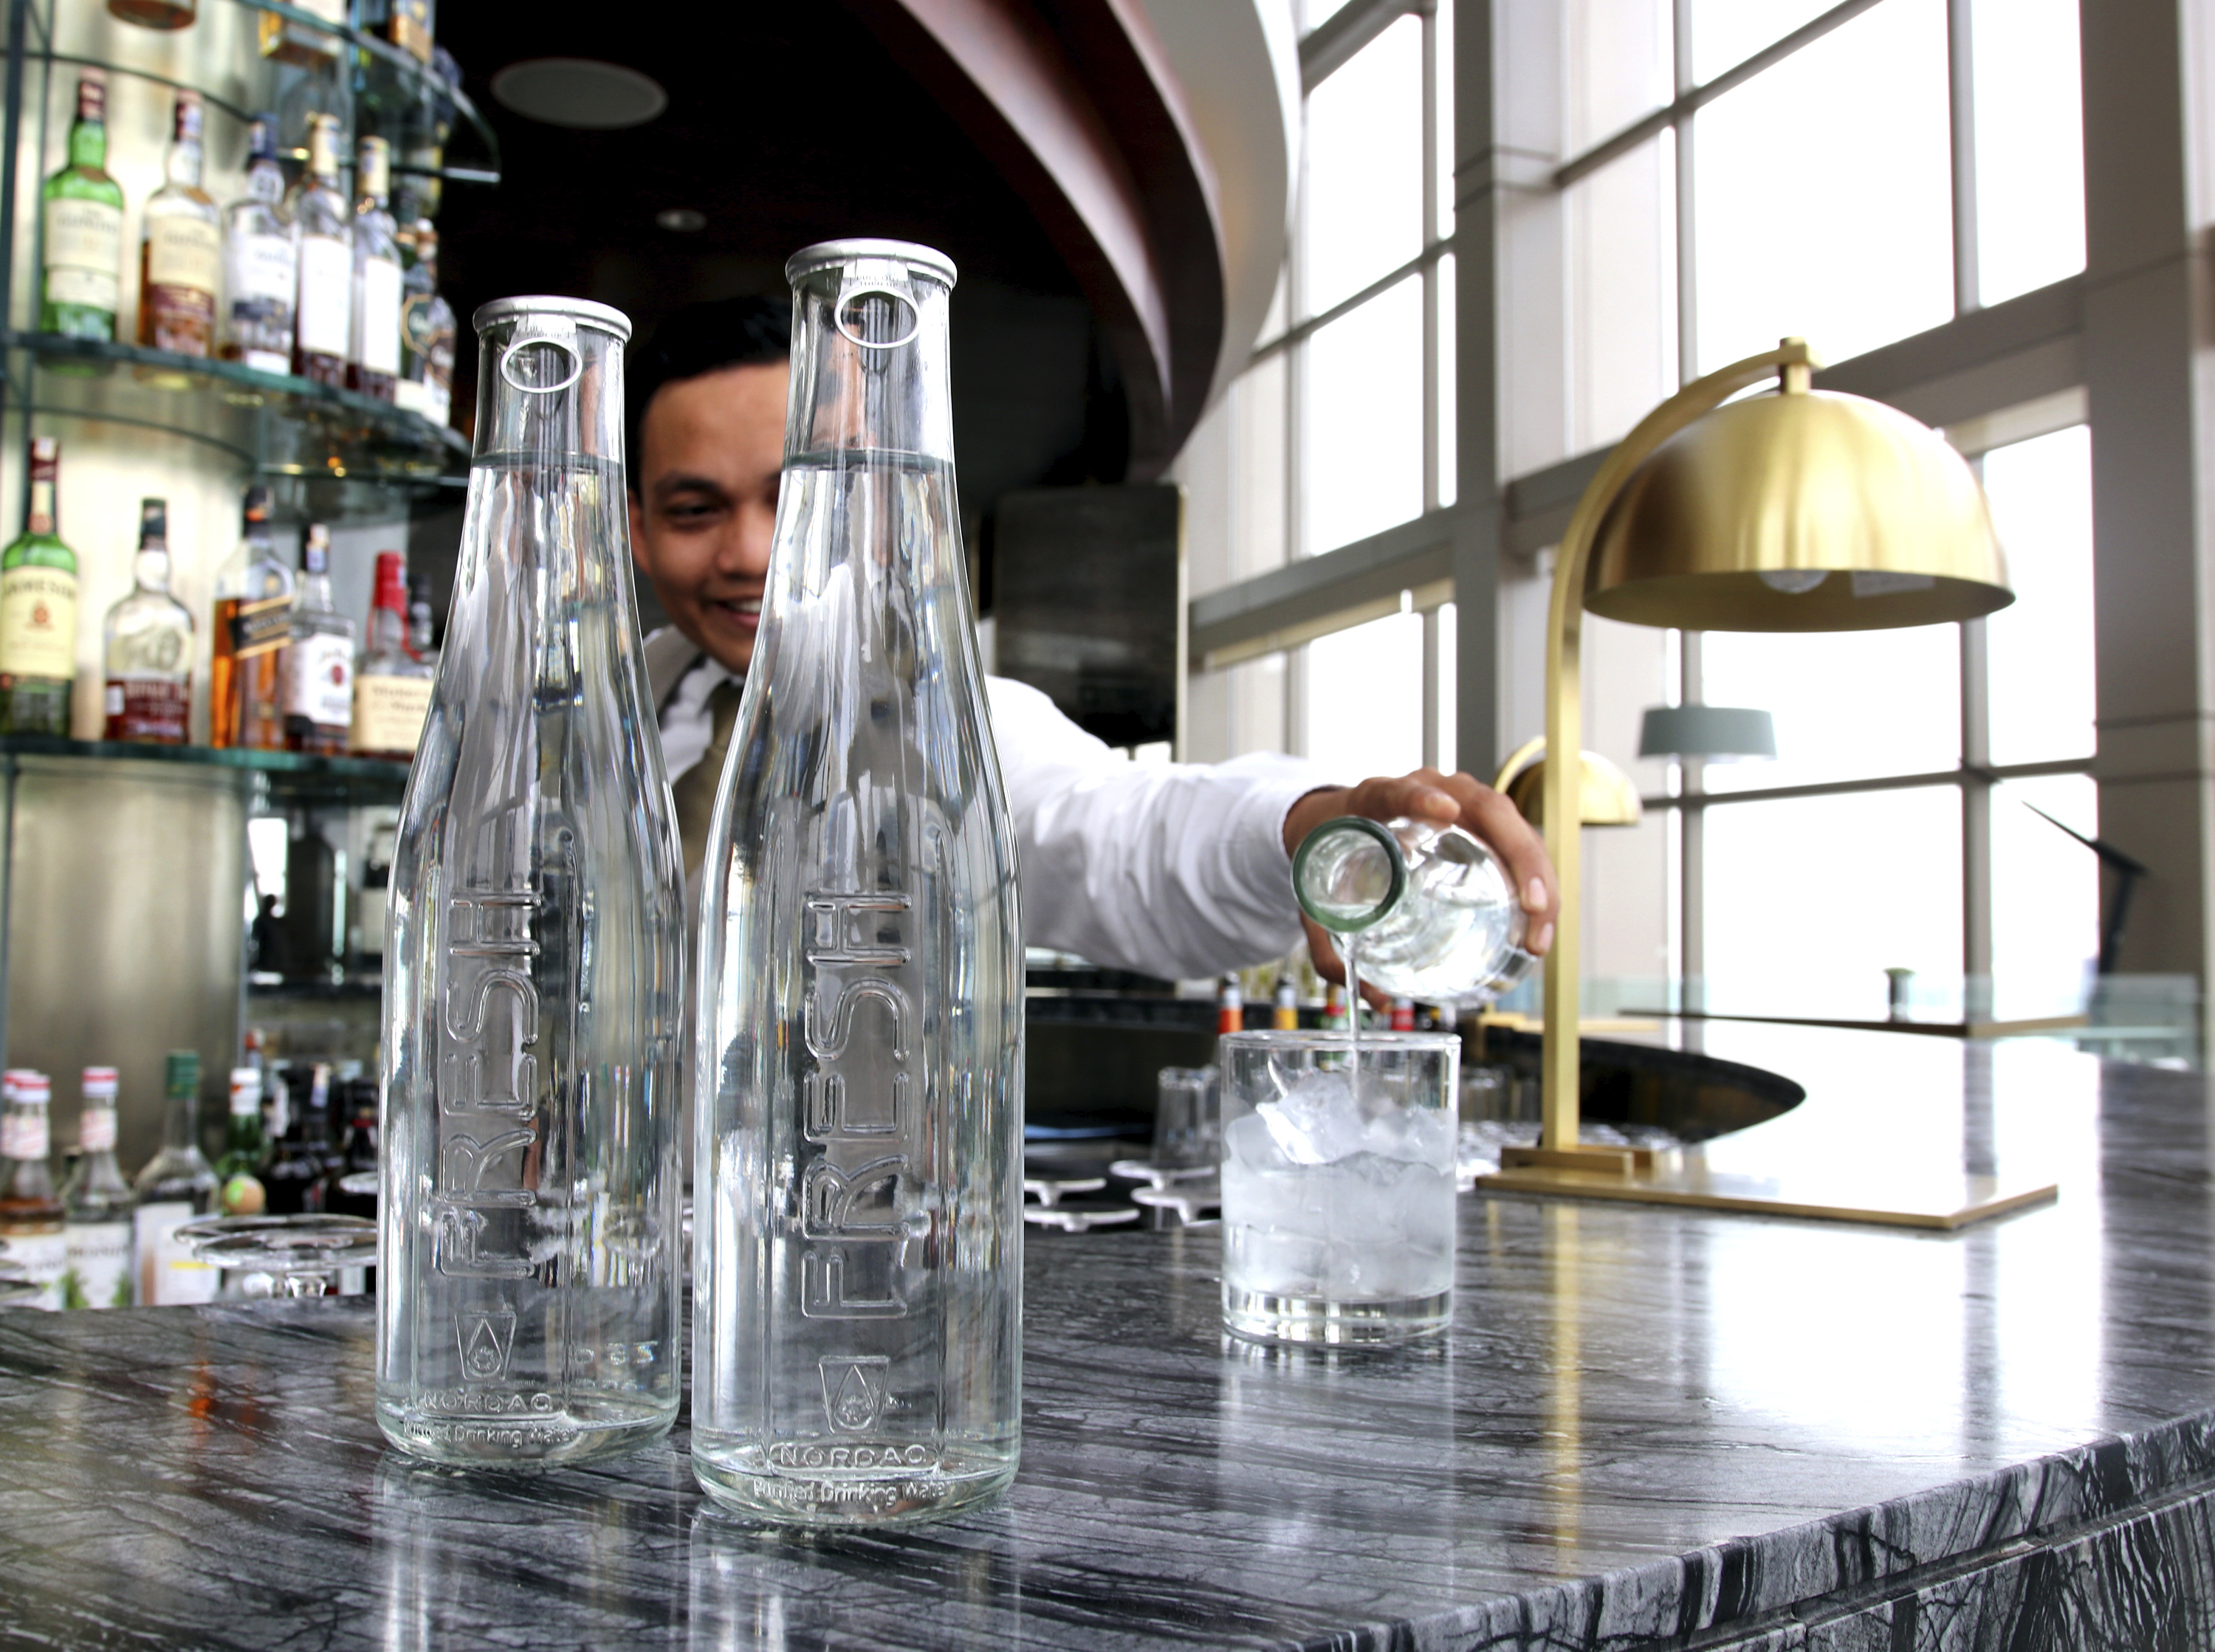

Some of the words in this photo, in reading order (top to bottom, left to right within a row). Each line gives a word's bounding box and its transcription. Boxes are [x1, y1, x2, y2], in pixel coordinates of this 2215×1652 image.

[441, 892, 543, 1278] FRESH
[802, 893, 914, 1318] FRESH
[423, 1391, 553, 1413] NORDAQ
[454, 1425, 523, 1448] Drinking
[820, 1479, 897, 1507] Drinking
